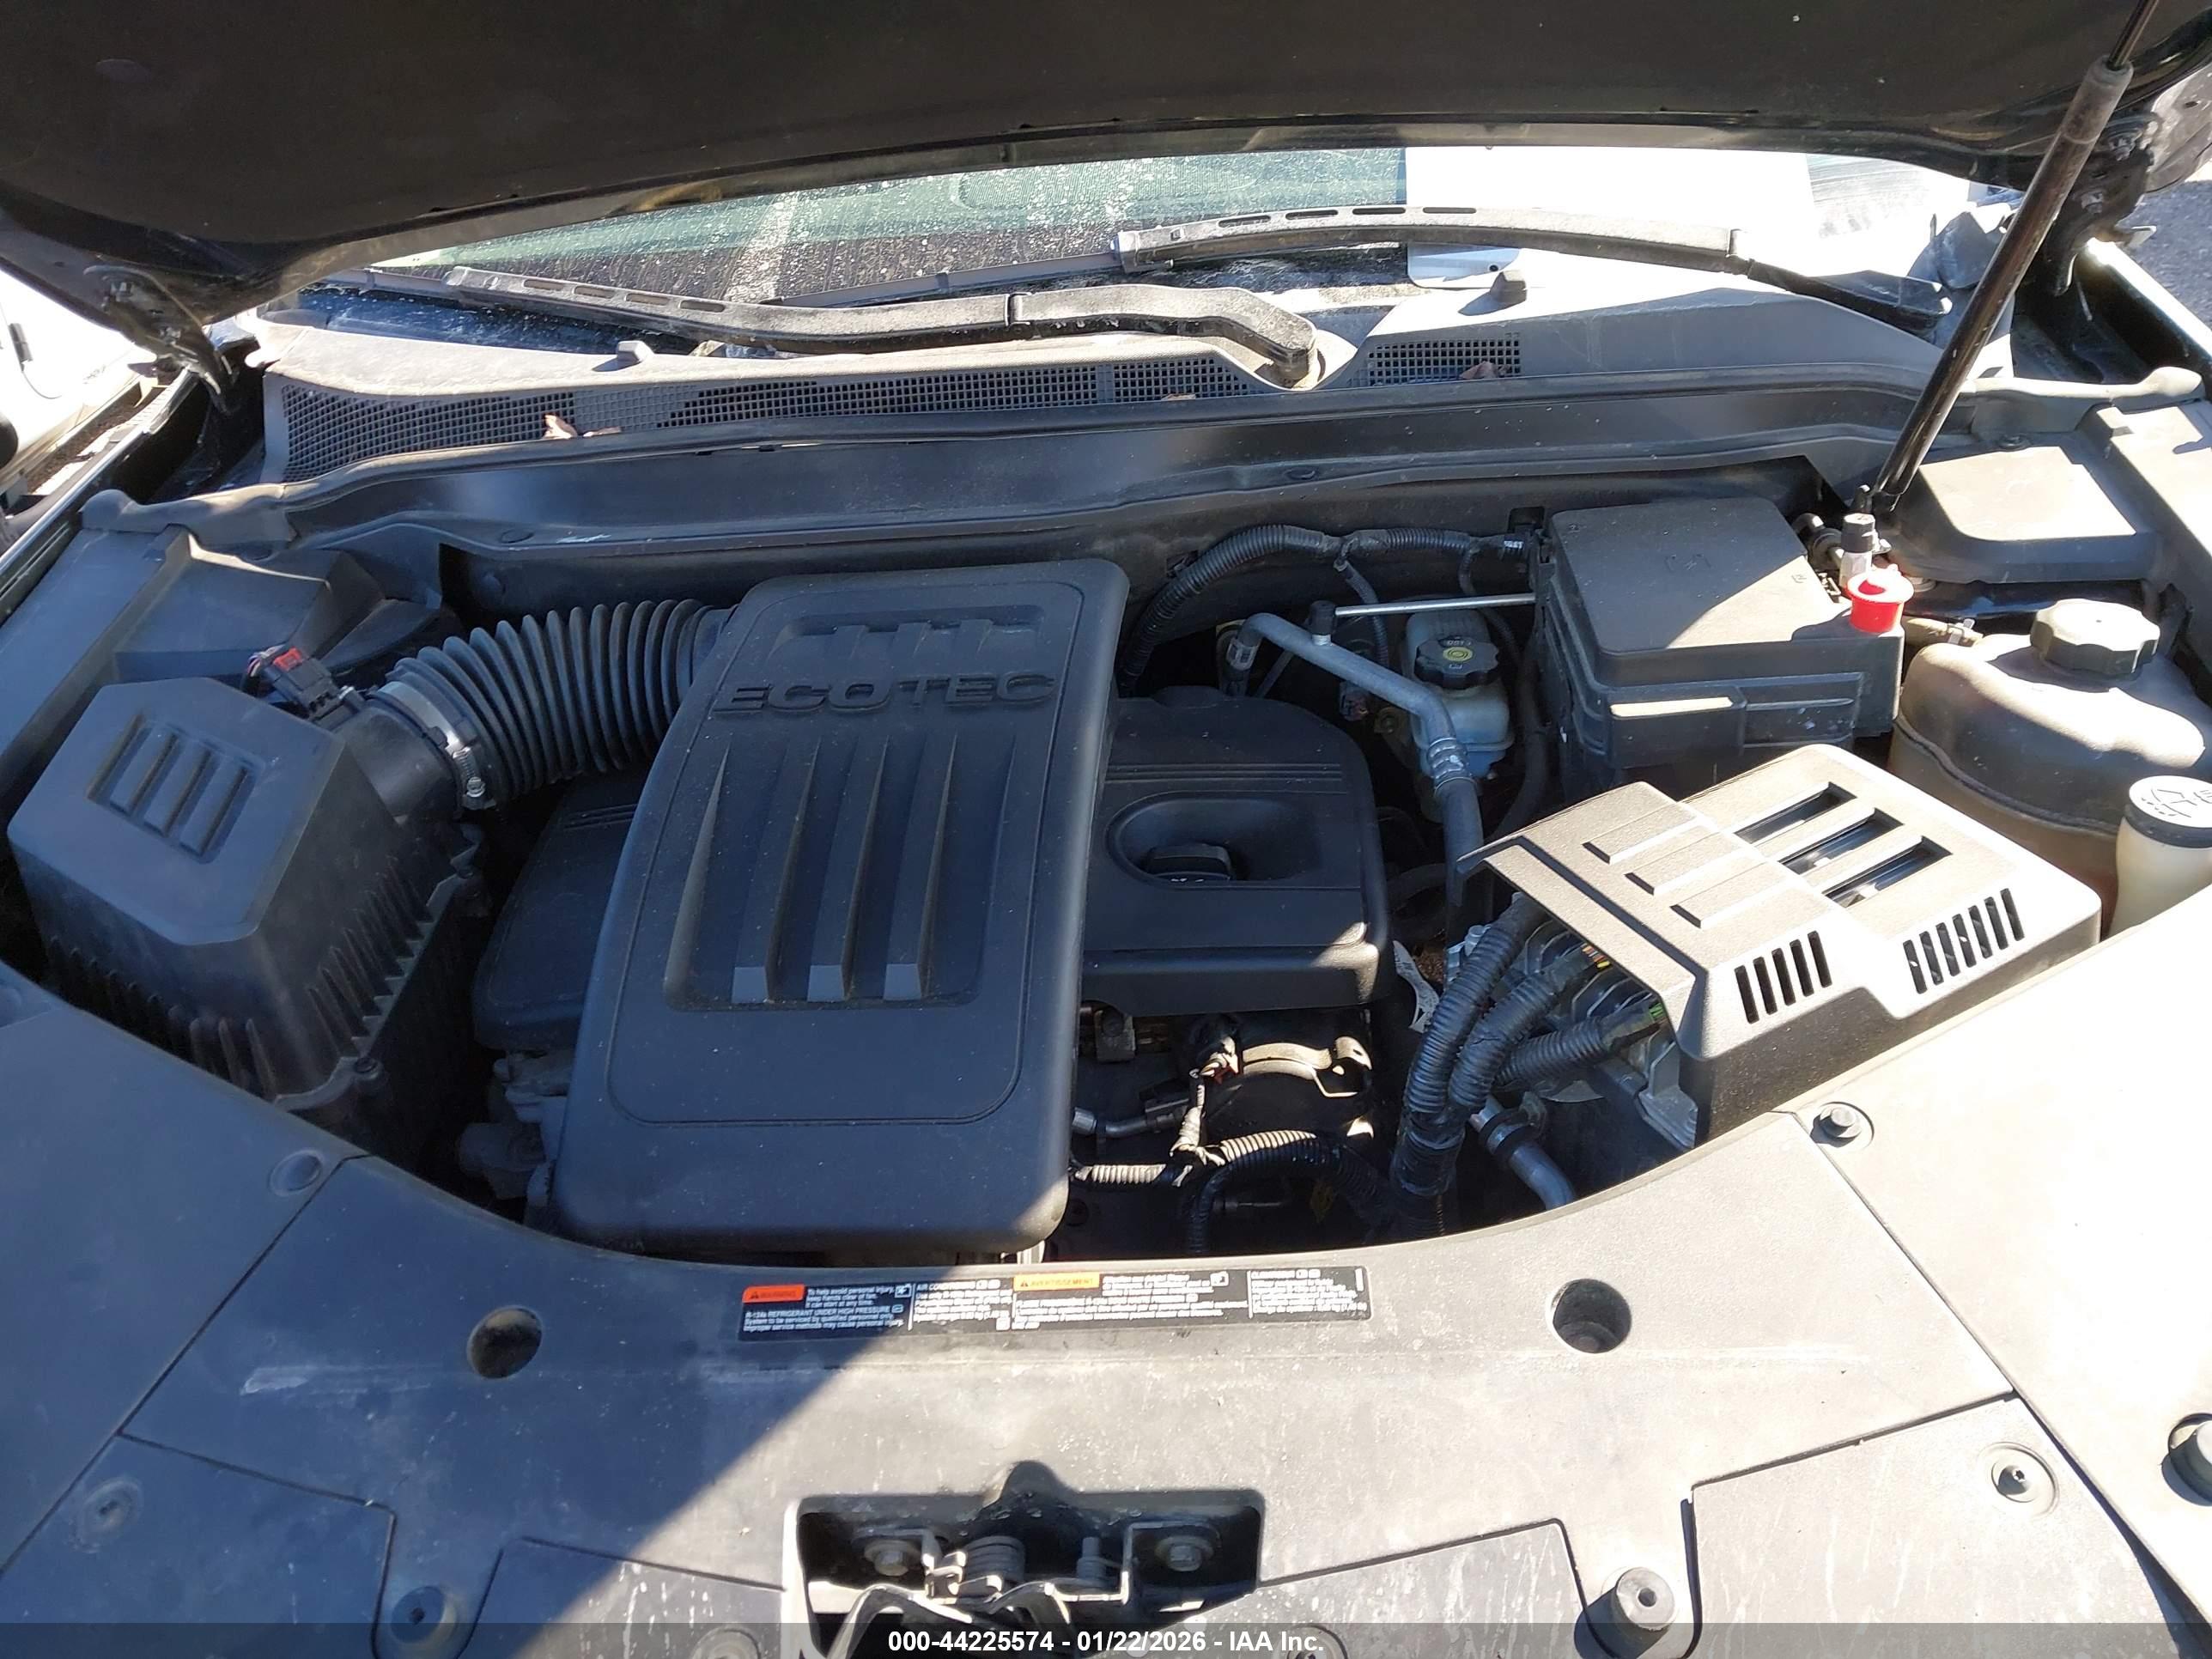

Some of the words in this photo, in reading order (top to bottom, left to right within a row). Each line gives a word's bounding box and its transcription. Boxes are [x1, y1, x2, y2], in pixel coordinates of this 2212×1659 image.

[713, 672, 1058, 714] ECOTEC
[1030, 1278, 1093, 1287] AVERTISSEMENT
[848, 1286, 876, 1295] personal
[768, 1309, 814, 1318] REFRIGERANT
[854, 1305, 891, 1315] PRESSURE
